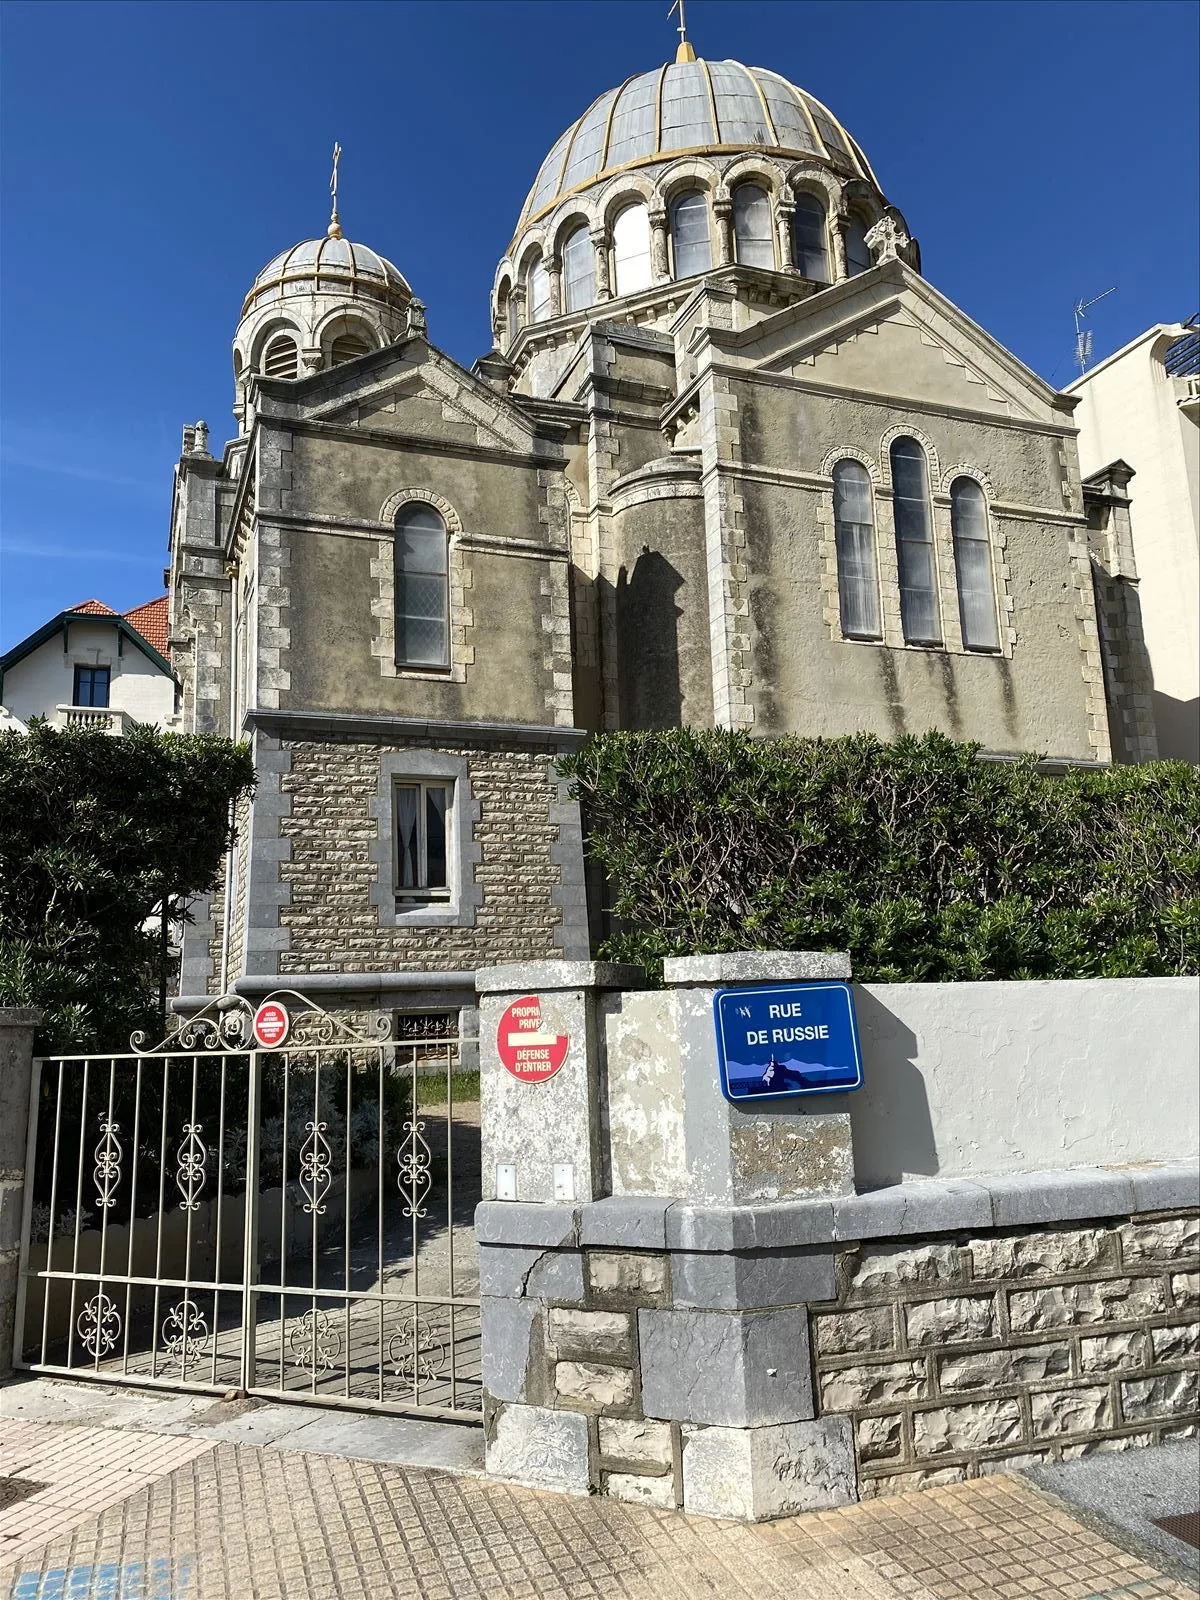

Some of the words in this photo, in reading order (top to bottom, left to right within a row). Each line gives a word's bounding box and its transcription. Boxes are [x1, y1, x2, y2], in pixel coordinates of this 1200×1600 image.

[512, 1006, 541, 1018] PROPRI
[769, 1003, 802, 1019] RUE
[746, 1030, 769, 1046] DE
[772, 1025, 830, 1043] RUSSIE
[517, 1047, 550, 1060] DÉFENSE
[515, 1061, 552, 1073] D'ENTRER
